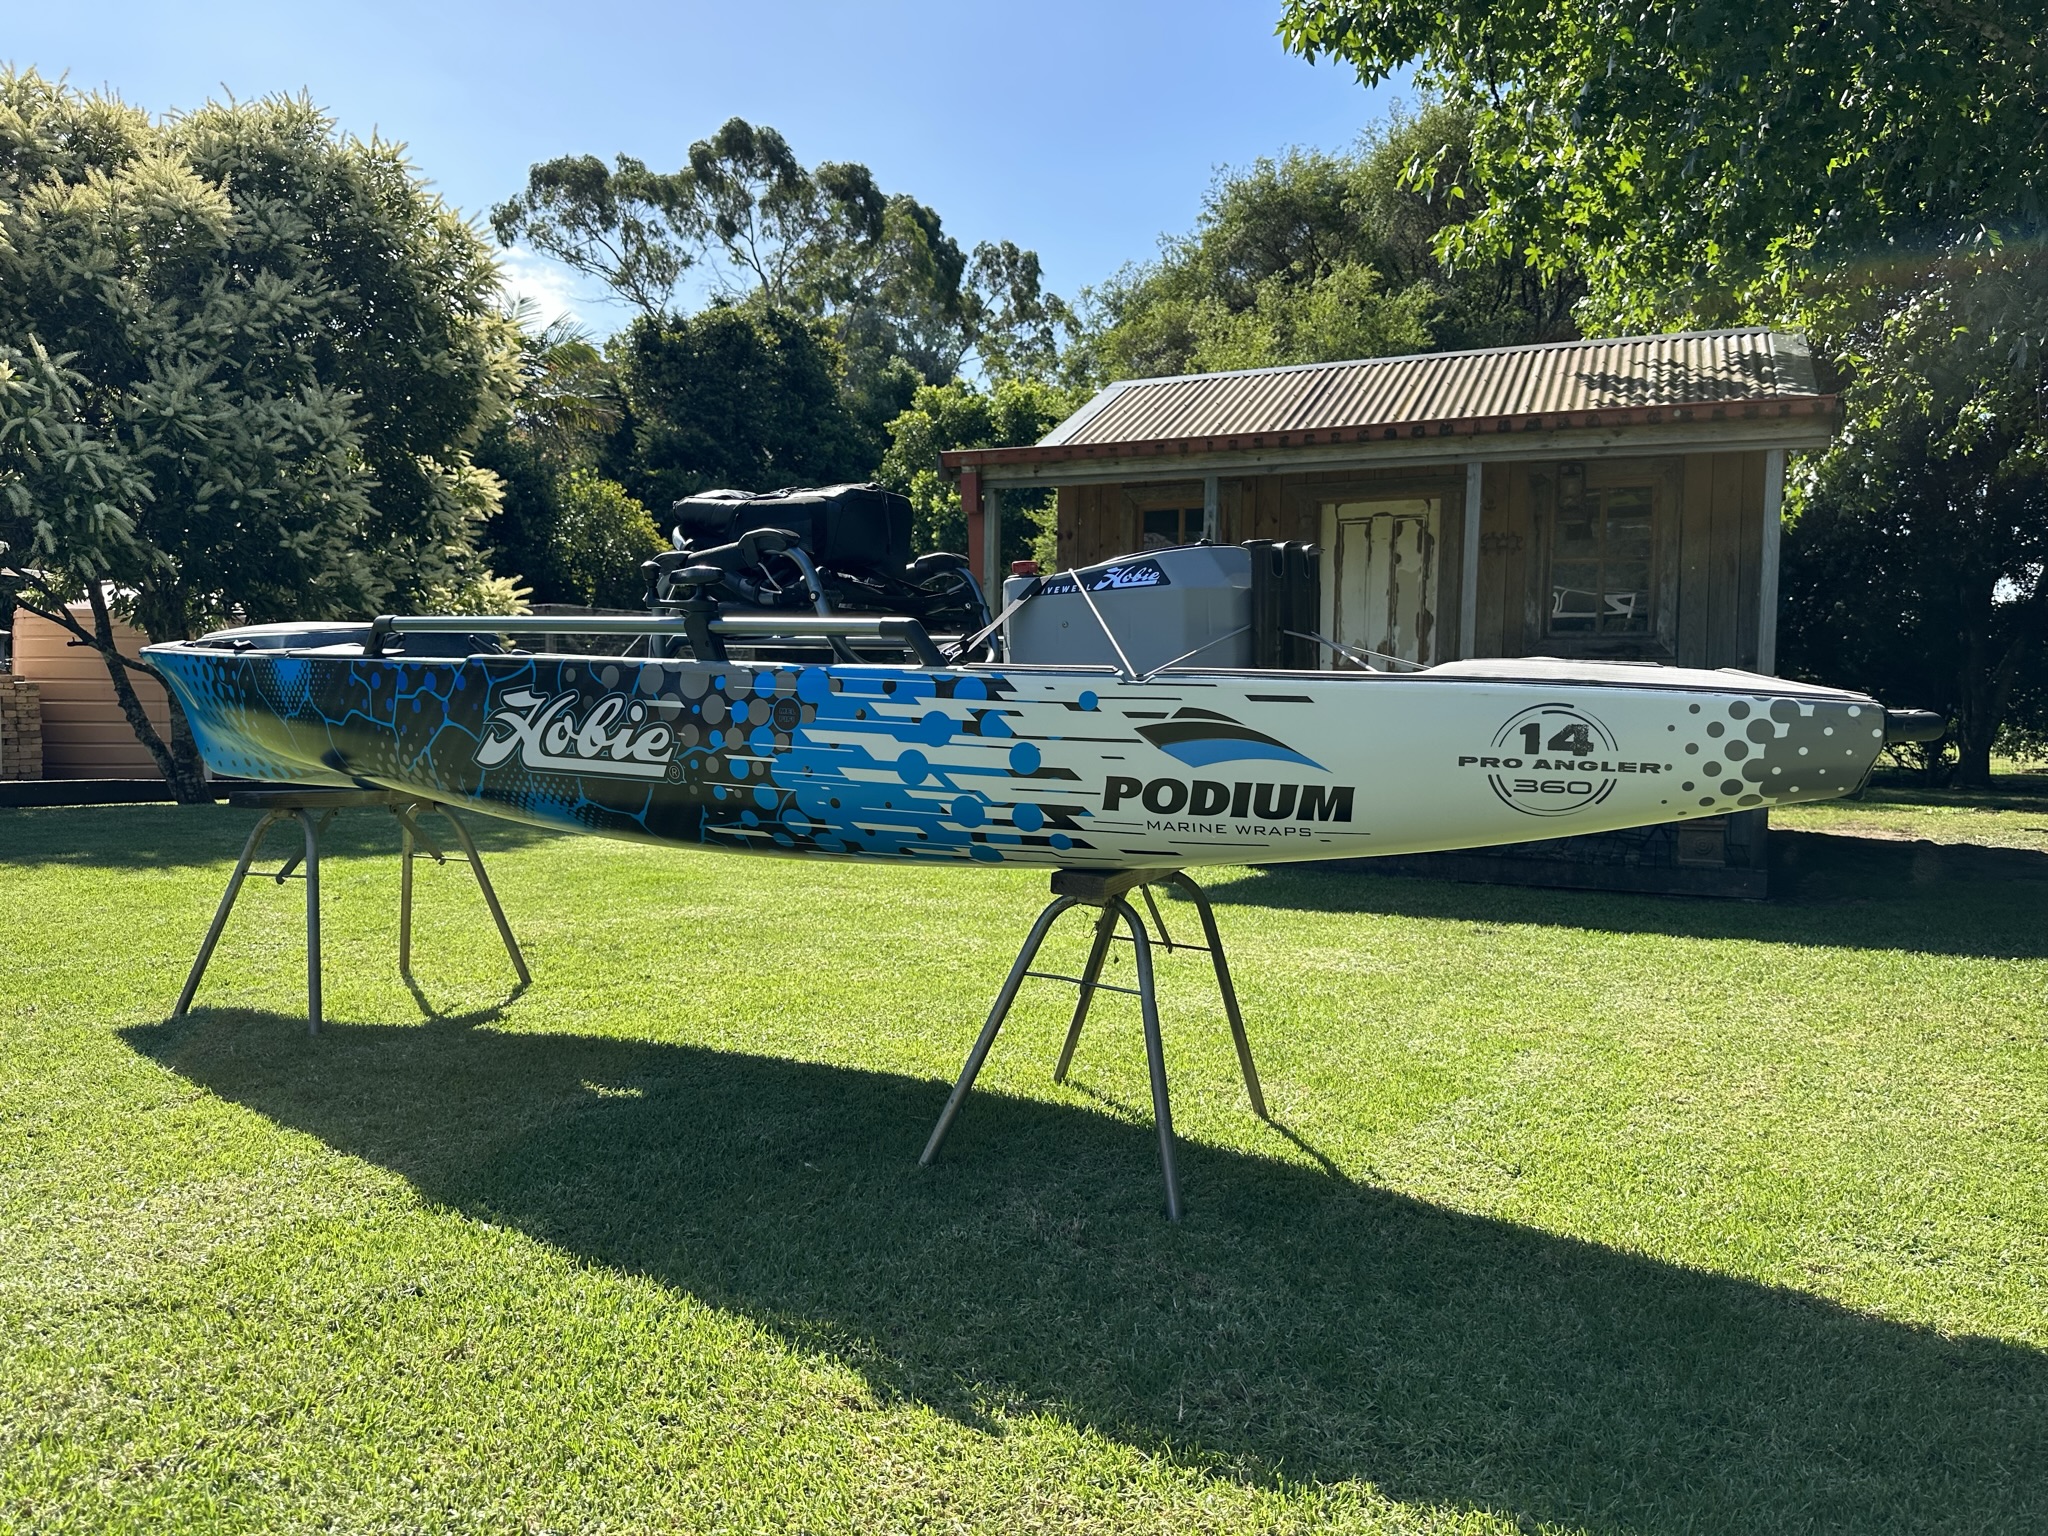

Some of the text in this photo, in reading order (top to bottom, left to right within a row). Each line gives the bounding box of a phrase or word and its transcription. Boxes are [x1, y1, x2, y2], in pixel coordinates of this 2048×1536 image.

[1041, 566, 1159, 595] IVEWEL Hobie
[476, 690, 674, 777] Hobie
[1519, 722, 1594, 756] 14
[1458, 756, 1661, 774] PRO ANGLER
[1102, 776, 1355, 822] PODIUM
[1513, 778, 1592, 794] 360
[1147, 820, 1312, 837] MARINE WRAPS
